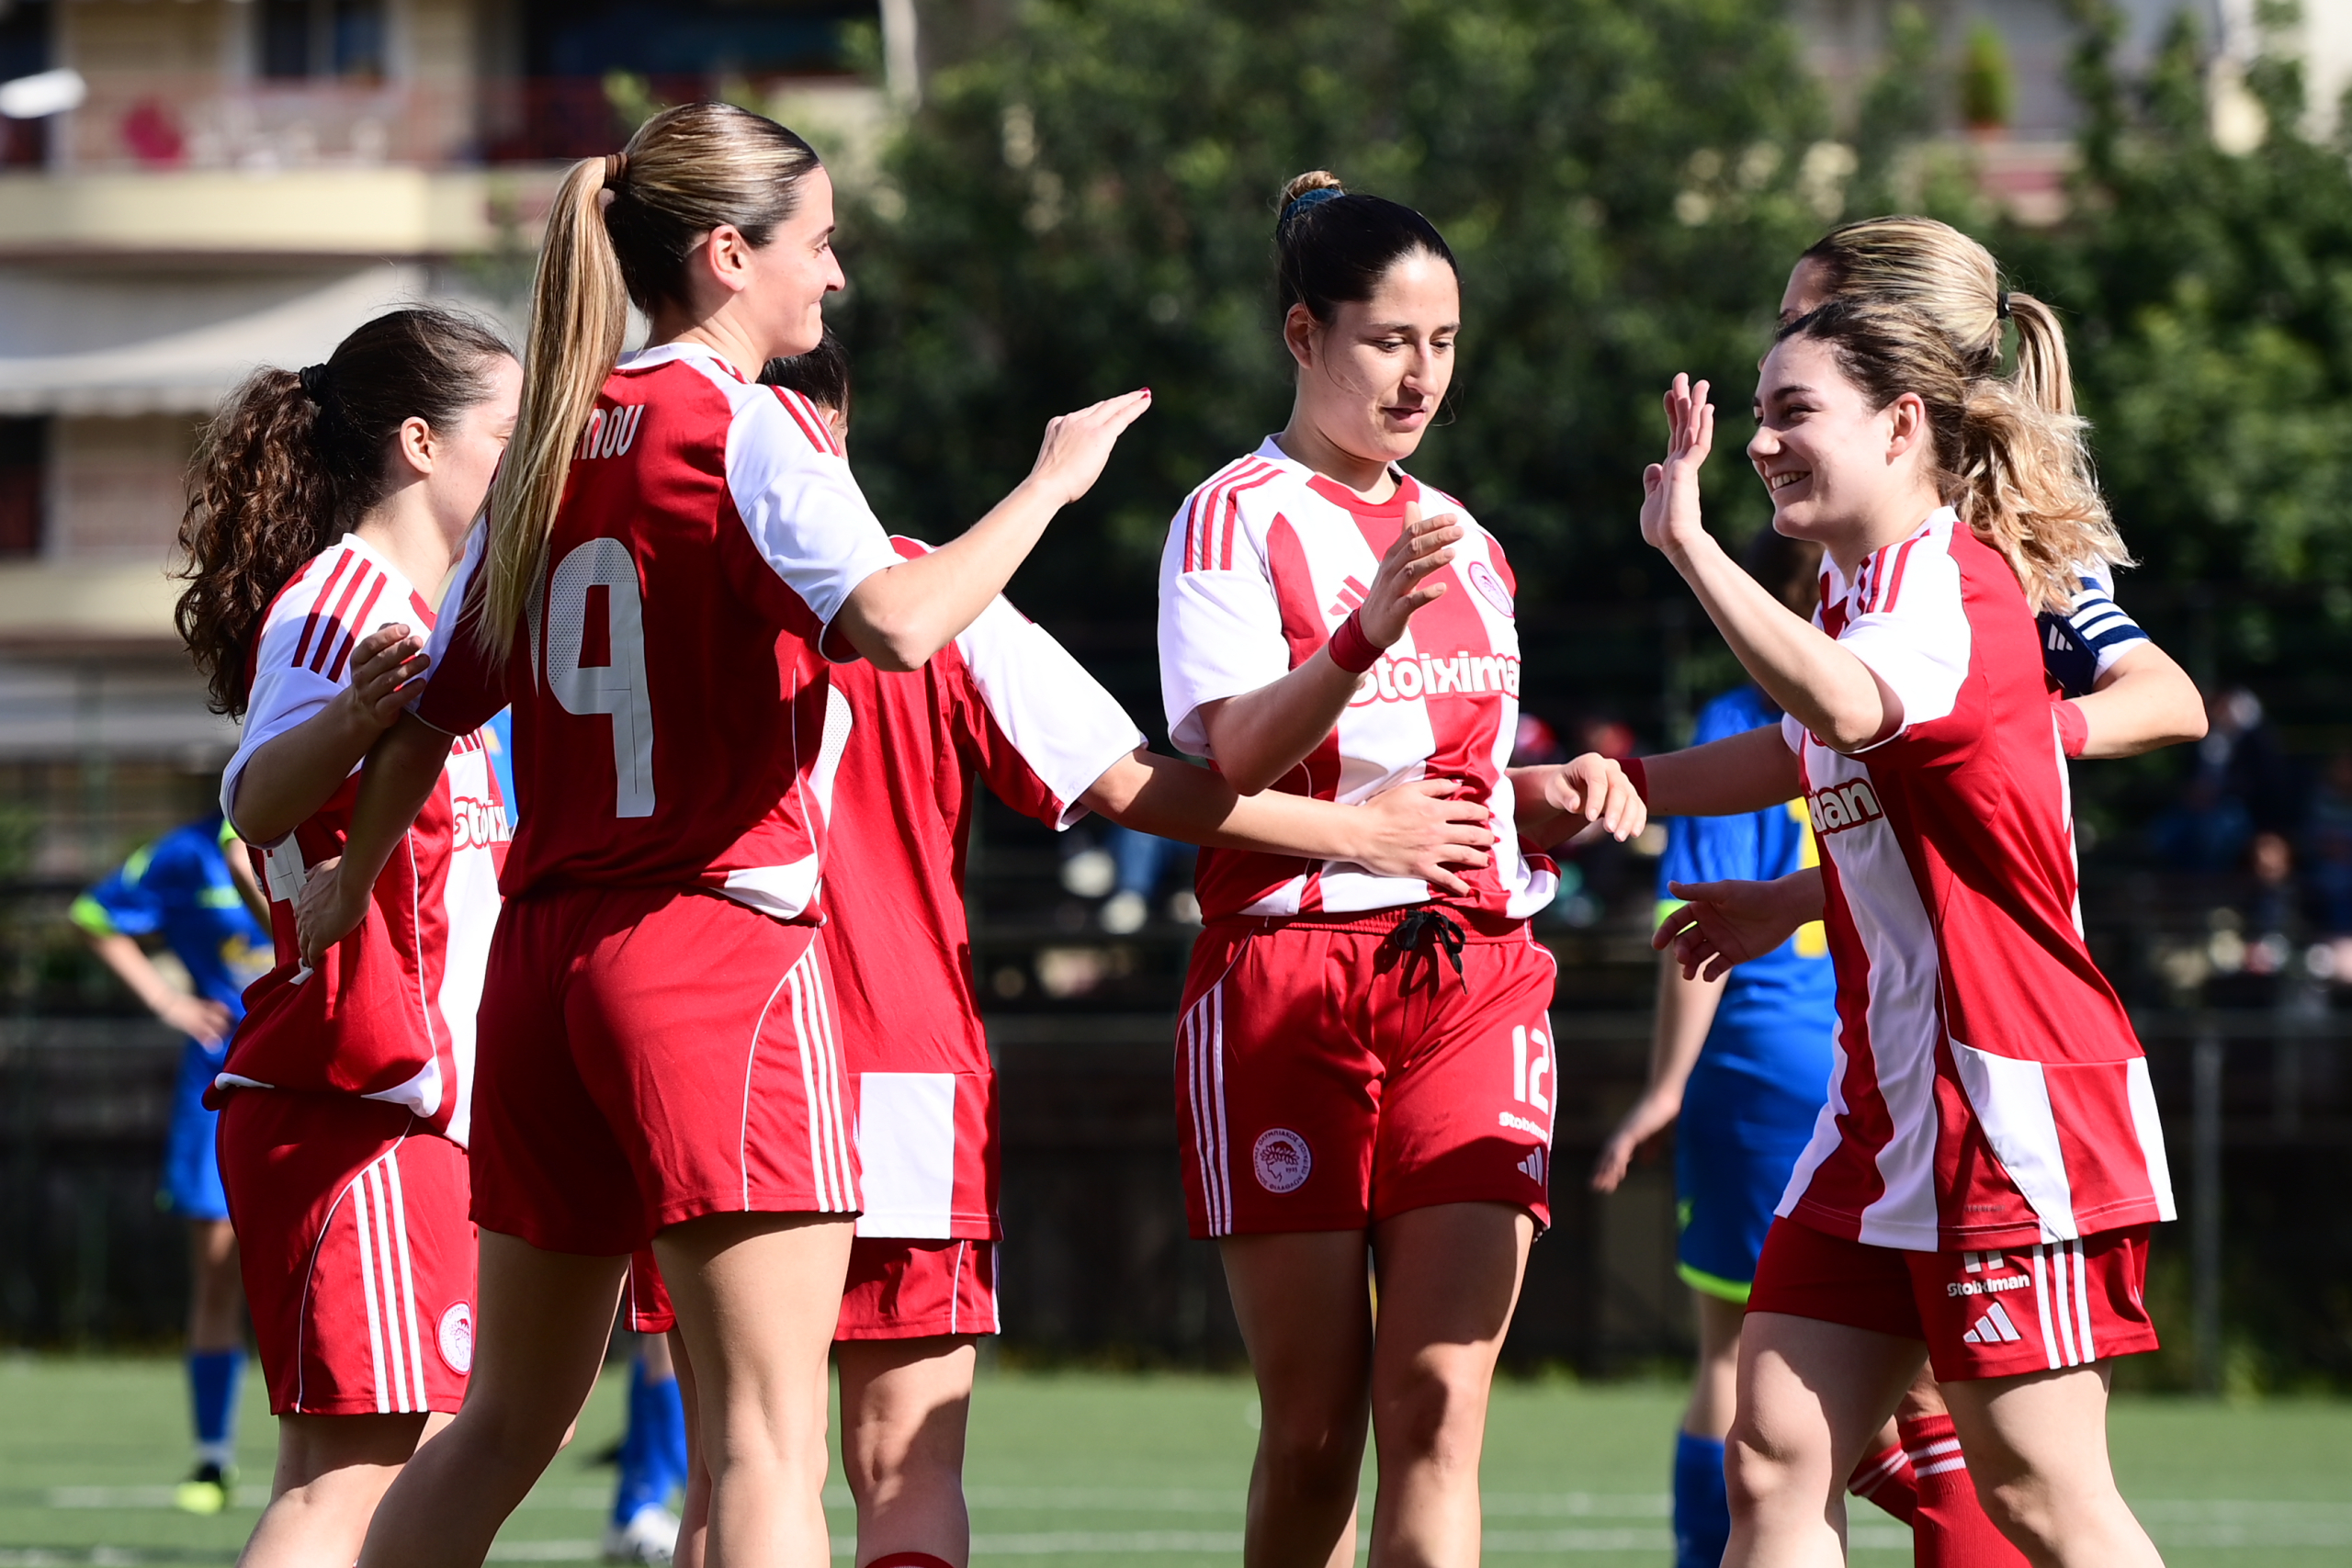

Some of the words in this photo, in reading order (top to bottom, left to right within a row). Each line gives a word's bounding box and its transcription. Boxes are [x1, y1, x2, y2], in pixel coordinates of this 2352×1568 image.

[573, 404, 645, 459] NOU
[1511, 1024, 1551, 1115] 12
[1947, 1274, 2031, 1297] Stoiximan
